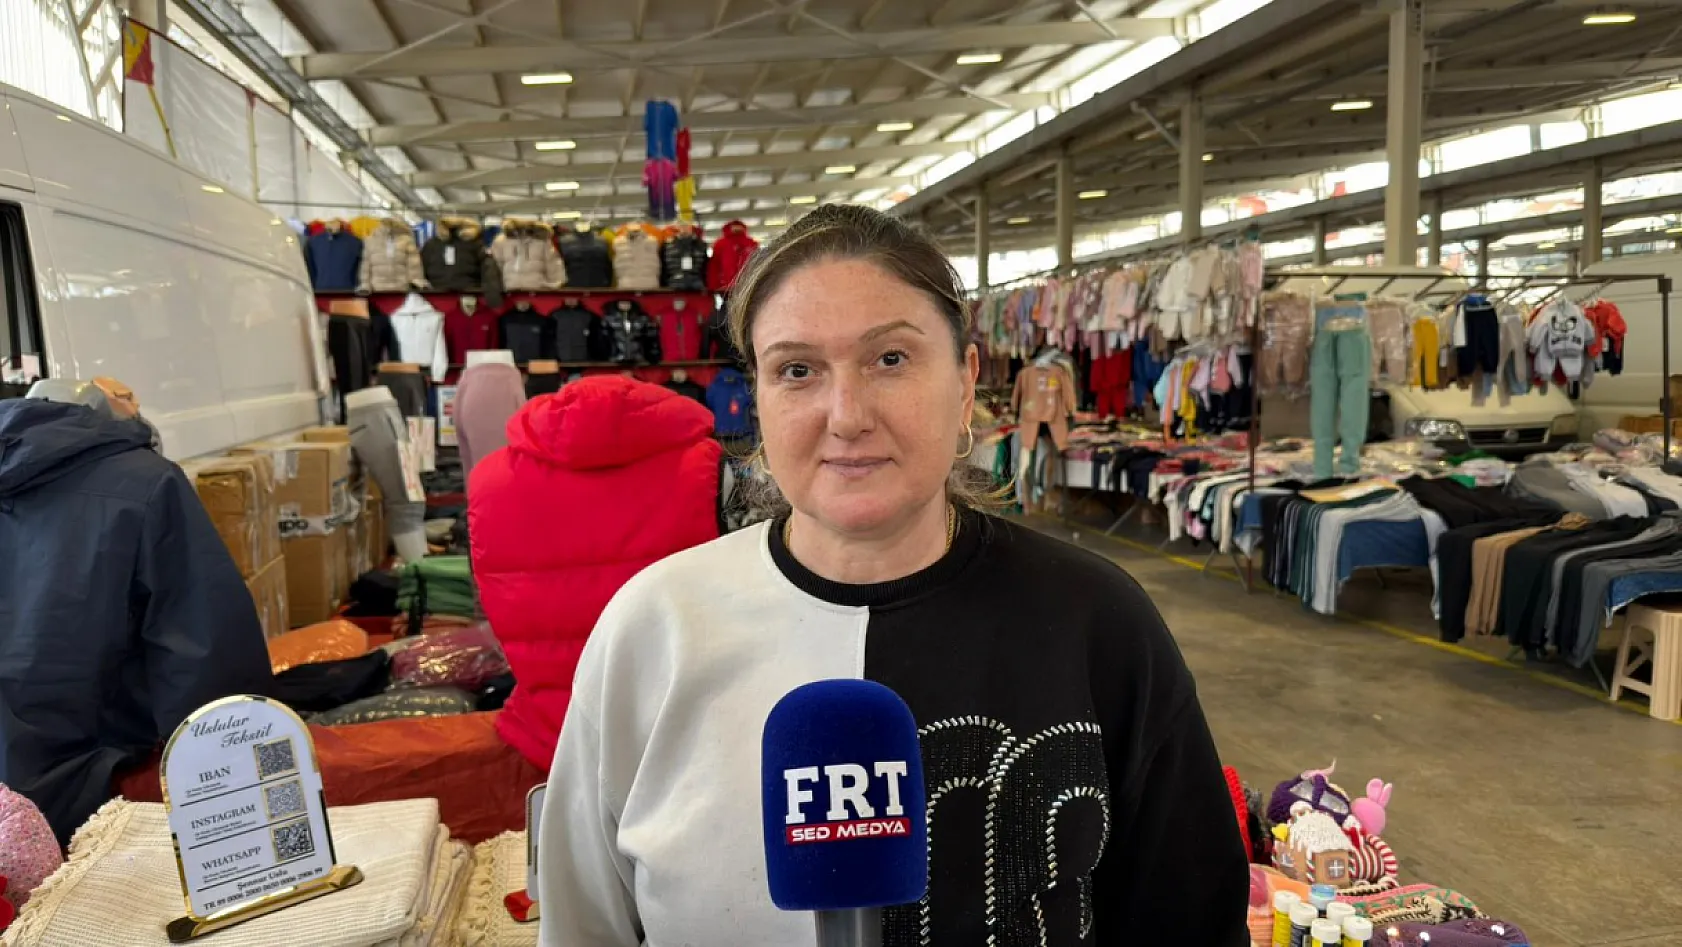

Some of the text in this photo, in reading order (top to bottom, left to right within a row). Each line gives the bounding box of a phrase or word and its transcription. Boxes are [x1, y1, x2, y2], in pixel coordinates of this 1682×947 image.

[220, 723, 274, 748] Tekstil
[199, 766, 232, 783] IBAN
[783, 760, 908, 824] FRT
[191, 804, 257, 829] INSTAGRAM
[791, 820, 906, 842] SED MEDYA
[201, 845, 262, 871] WHATSAPP
